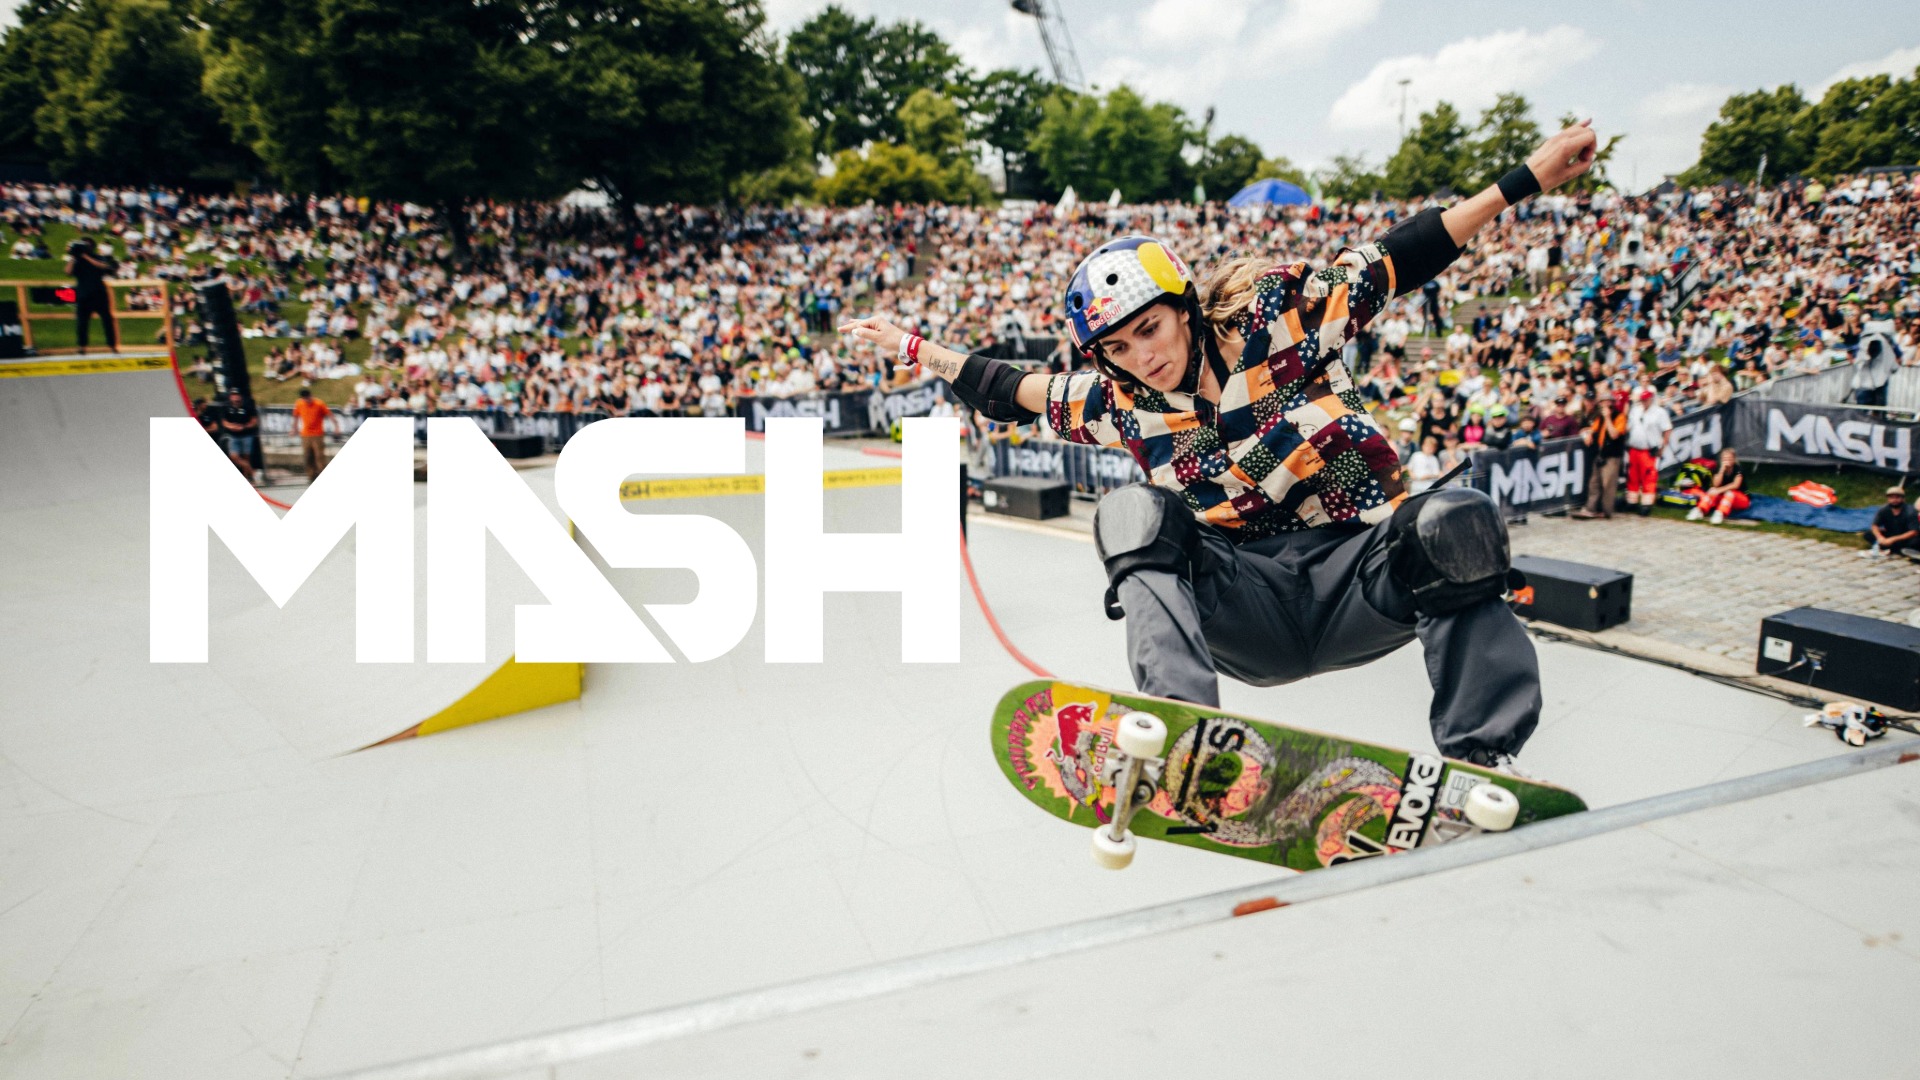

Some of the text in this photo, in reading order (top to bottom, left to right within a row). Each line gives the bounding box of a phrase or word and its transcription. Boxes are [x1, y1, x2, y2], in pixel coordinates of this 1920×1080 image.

[1090, 304, 1122, 330] Red Bull
[1766, 407, 1911, 472] MASH
[1489, 448, 1585, 506] MASH
[1095, 727, 1115, 754] Bull
[1386, 753, 1446, 850] EVOKE
